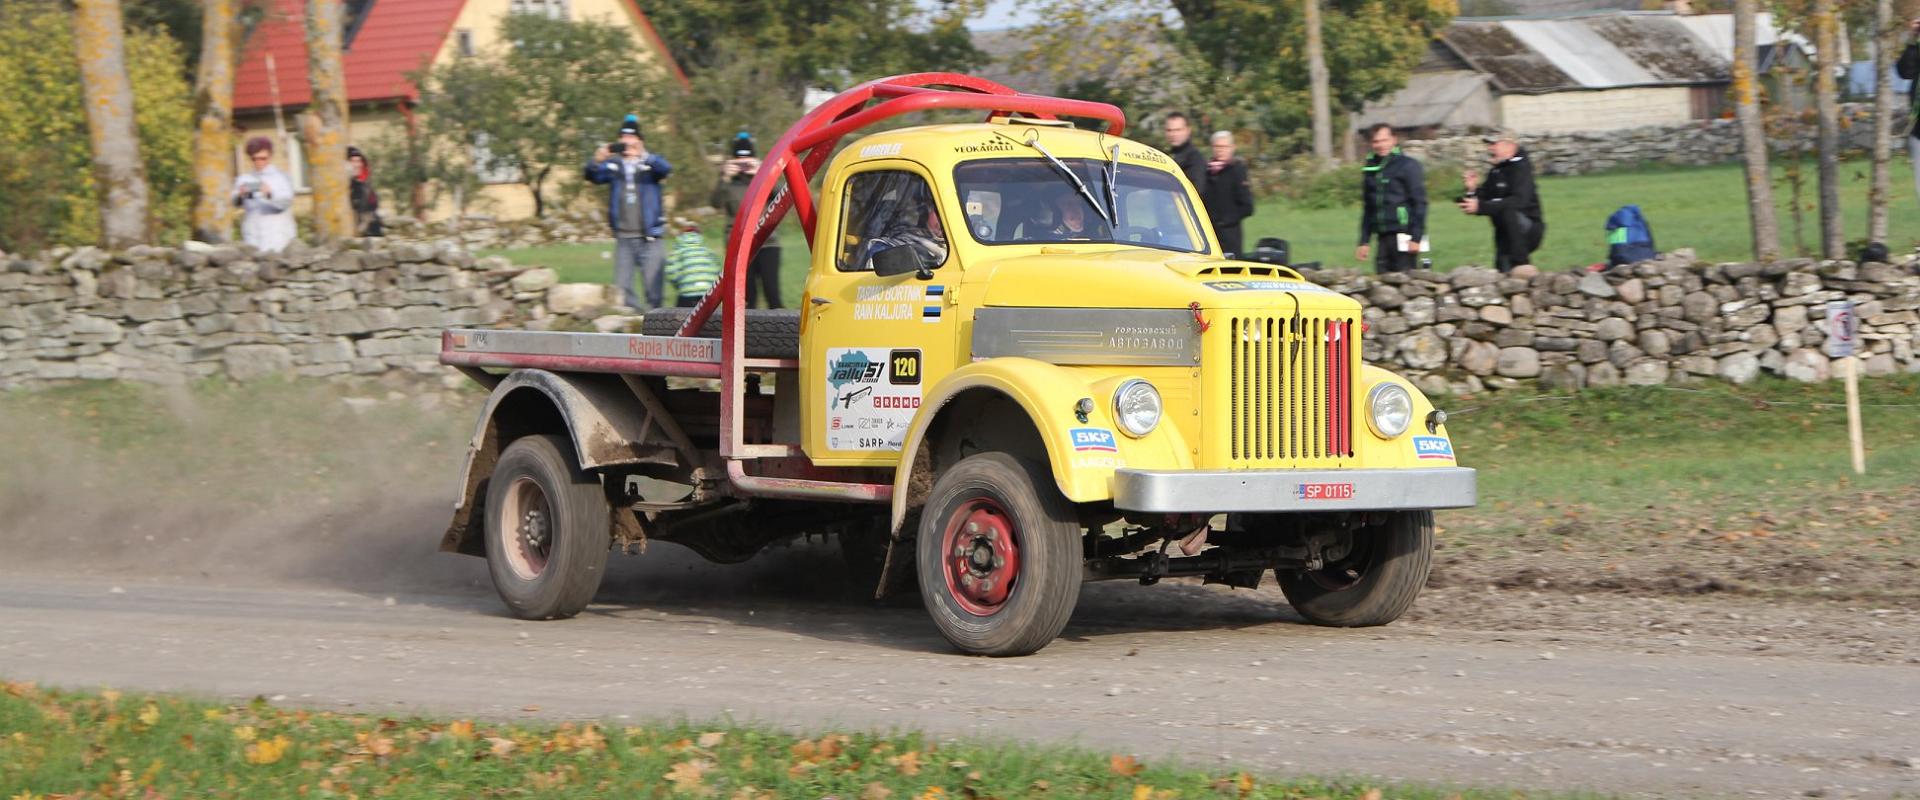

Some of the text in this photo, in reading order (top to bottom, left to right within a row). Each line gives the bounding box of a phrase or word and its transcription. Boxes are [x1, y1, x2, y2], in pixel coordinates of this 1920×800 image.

[854, 303, 913, 320] RAIN KALJURA
[628, 336, 663, 358] Rapla
[1108, 336, 1184, 350] АВТОЗАВОД
[833, 362, 886, 383] rally 51
[893, 357, 917, 377] 120
[873, 396, 920, 408] CRAMO
[859, 437, 884, 448] SARP
[1076, 431, 1111, 443] SKF
[1418, 439, 1448, 451] SKF
[1306, 484, 1351, 498] SP 0115
